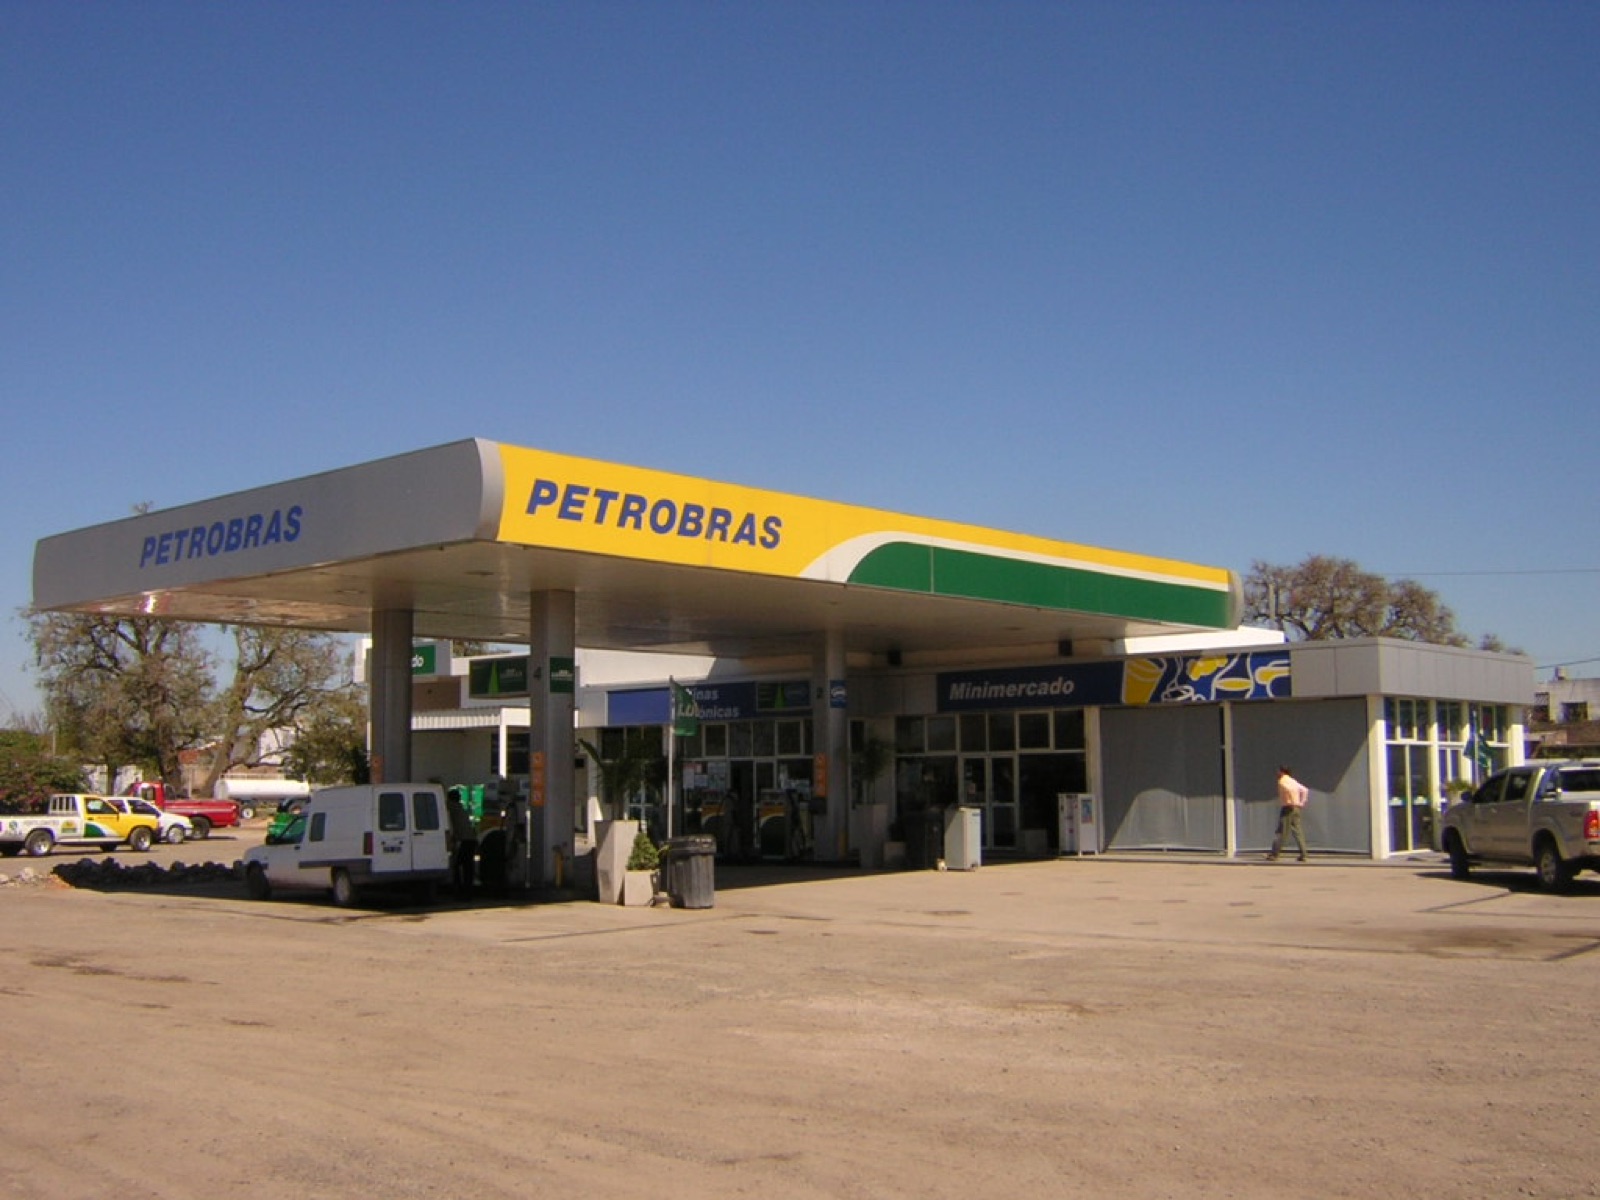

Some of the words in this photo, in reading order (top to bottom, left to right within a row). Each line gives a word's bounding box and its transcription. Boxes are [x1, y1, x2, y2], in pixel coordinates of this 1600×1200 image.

[139, 504, 304, 568] PETROBRAS
[525, 478, 782, 550] PETROBRAS
[949, 676, 1075, 700] Minimercado
